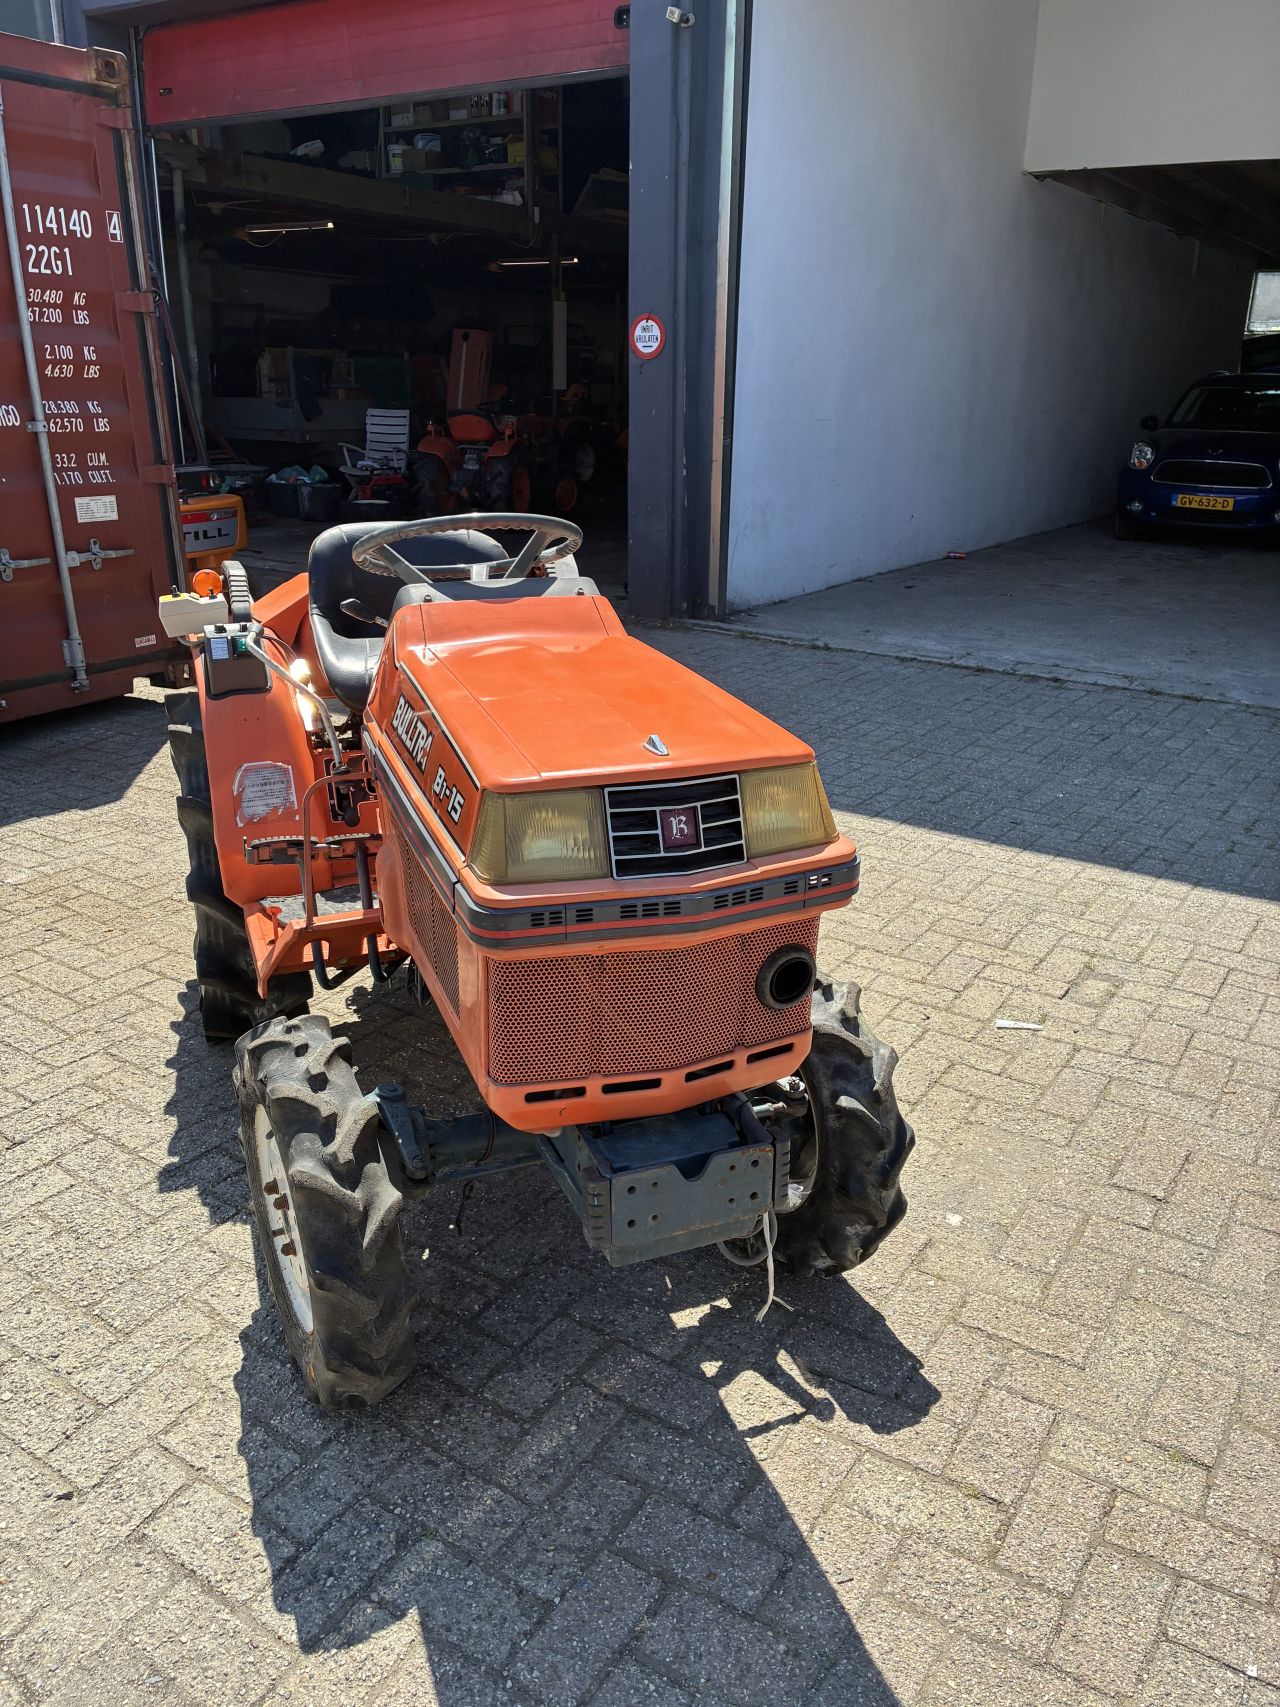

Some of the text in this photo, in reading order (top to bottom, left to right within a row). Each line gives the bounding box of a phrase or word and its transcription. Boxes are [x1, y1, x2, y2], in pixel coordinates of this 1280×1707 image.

[23, 203, 121, 241] 114140 4
[26, 244, 73, 276] 22G1
[28, 288, 87, 306] 30.480 KG
[28, 307, 90, 325] 67.200 LBS
[44, 344, 97, 361] 2.100 KG
[44, 364, 100, 378] 4.630 LBS
[42, 400, 102, 414] 28.380 KG
[50, 418, 110, 433] 62.570 LBS
[55, 453, 77, 468] 33.2
[53, 471, 83, 486] 1.170
[391, 691, 435, 776] BULLTRA
